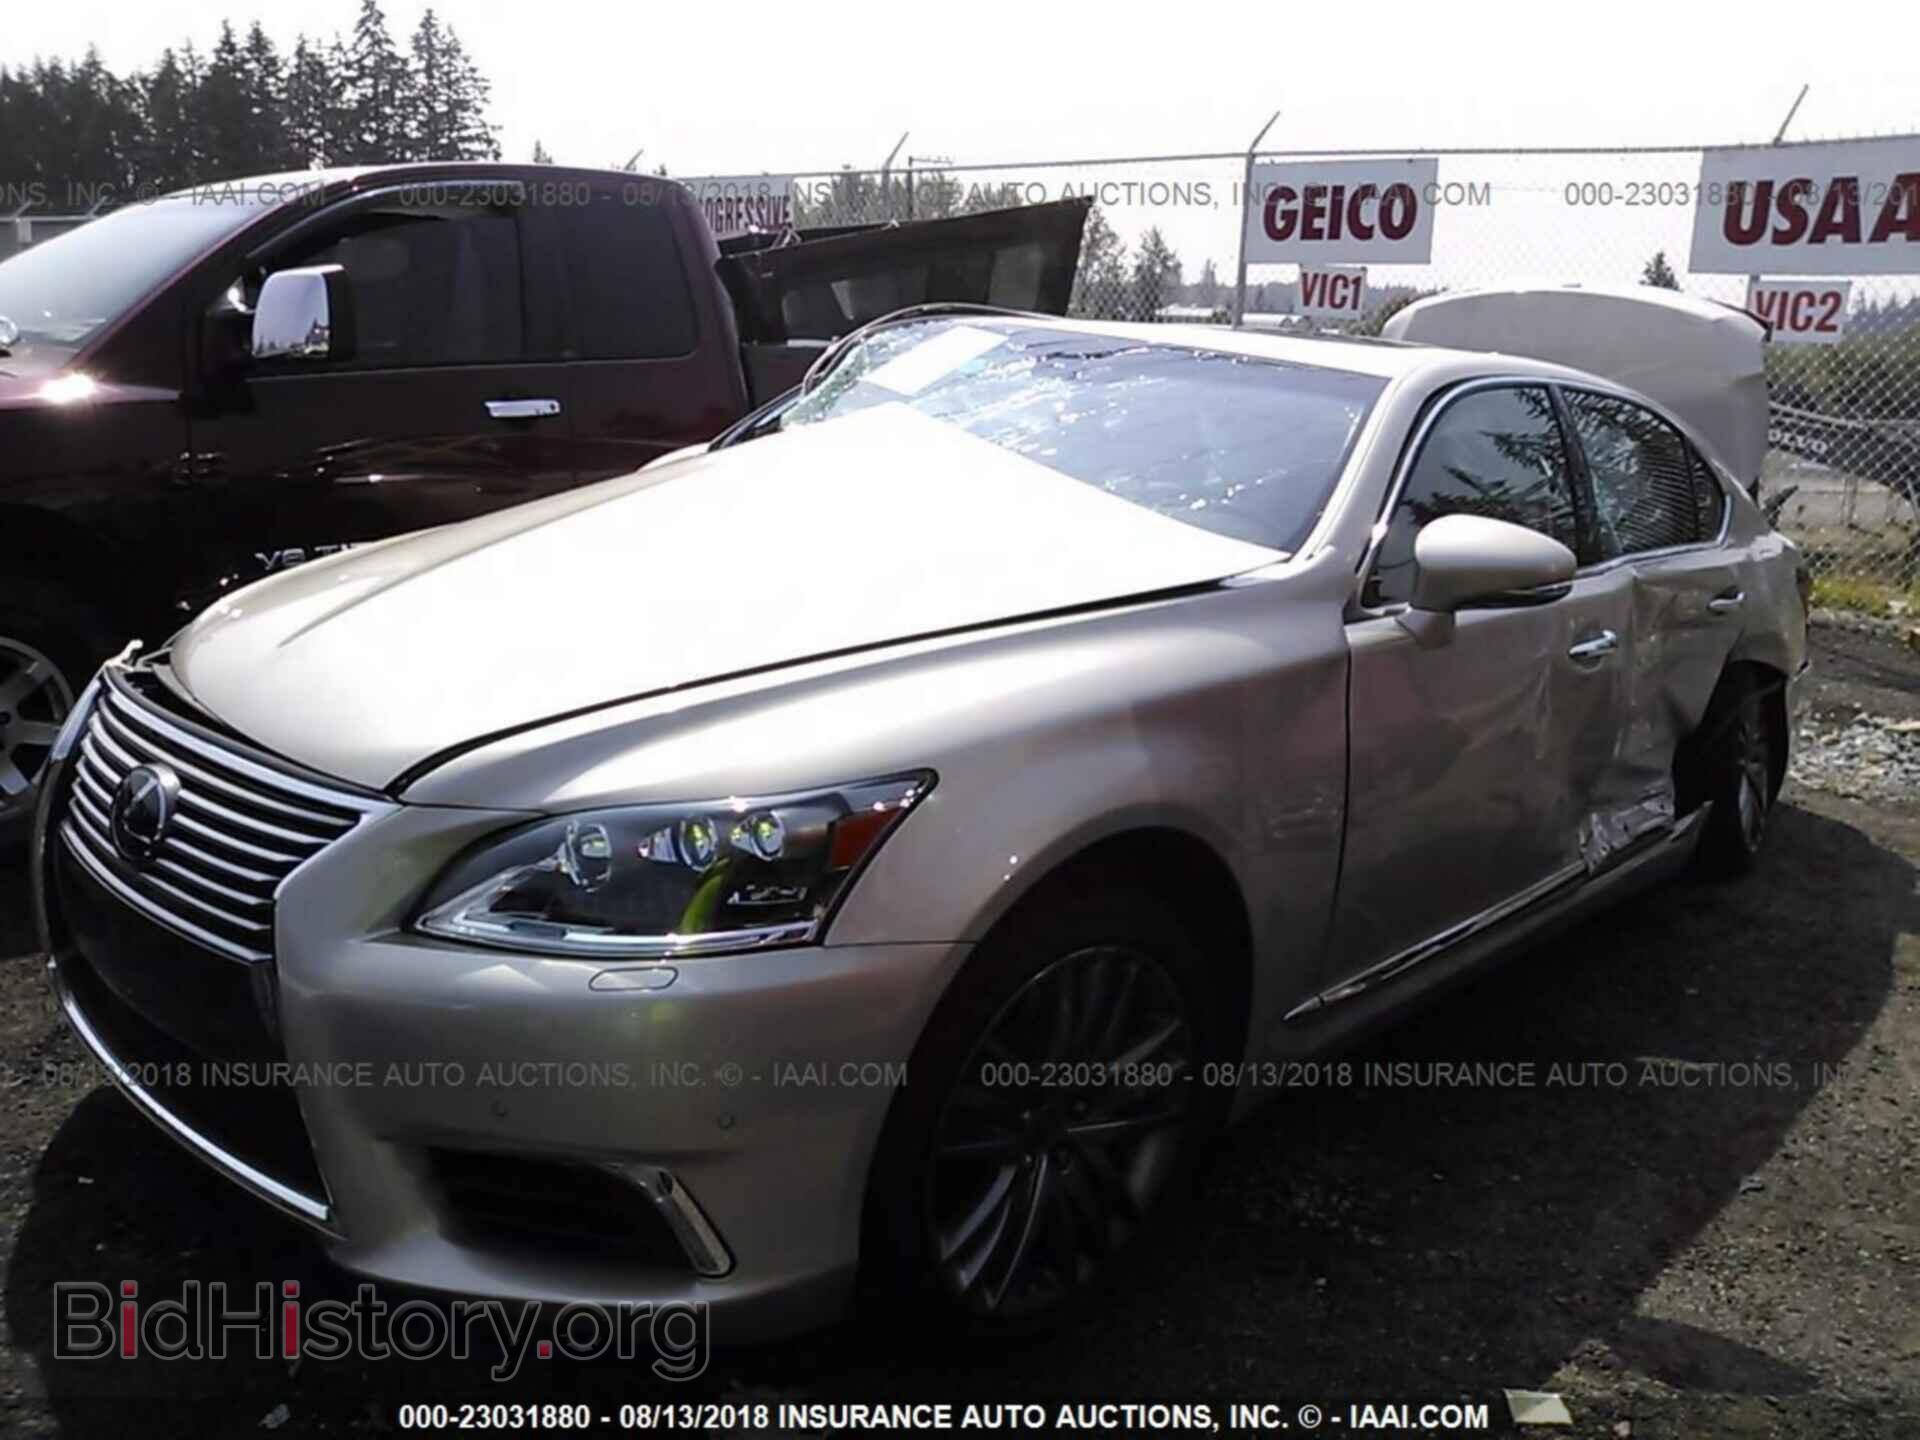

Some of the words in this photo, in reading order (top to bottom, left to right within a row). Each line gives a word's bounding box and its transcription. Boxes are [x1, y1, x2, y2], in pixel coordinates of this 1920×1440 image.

[702, 195, 792, 232] OGRESSIVE
[1263, 183, 1417, 241] GEICO
[1723, 172, 1920, 246] USAA
[1301, 276, 1362, 311] VIC1
[1755, 290, 1842, 332] VIC2
